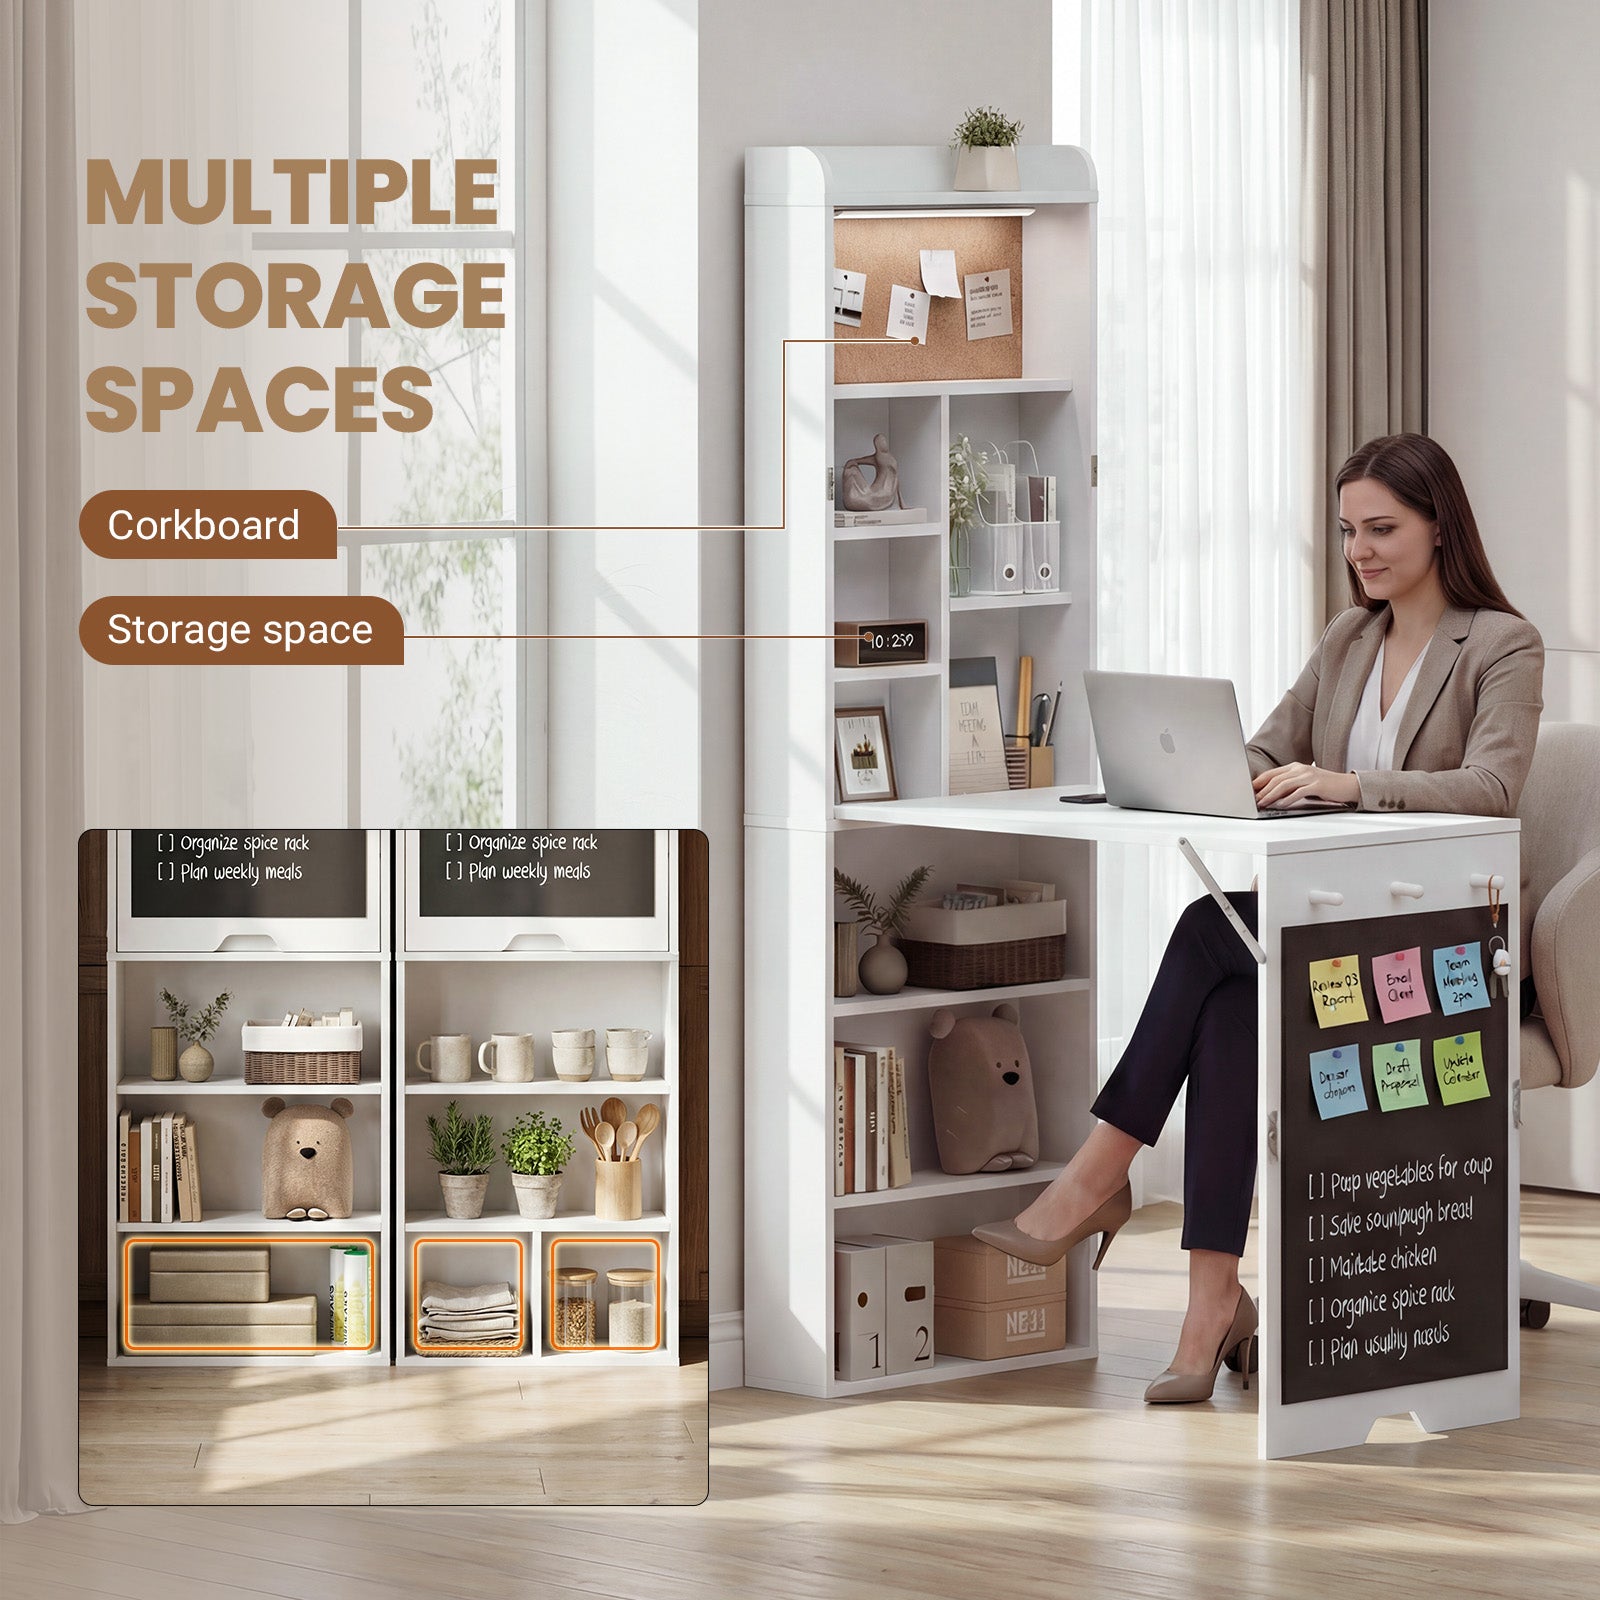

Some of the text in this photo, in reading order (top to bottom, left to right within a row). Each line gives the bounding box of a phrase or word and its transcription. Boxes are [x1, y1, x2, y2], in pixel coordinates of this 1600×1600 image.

[180, 834, 239, 859] Organize
[243, 834, 279, 859] spice
[284, 834, 310, 851] rack
[468, 833, 528, 858] Organize
[532, 833, 568, 858] spice
[572, 833, 598, 850] rack
[180, 862, 208, 883] Plan
[214, 862, 260, 887] weekly
[265, 862, 303, 881] meals
[468, 861, 496, 882] Plan
[502, 861, 548, 886] weekly
[554, 861, 592, 880] meals
[1365, 1160, 1434, 1200] vegetables
[1438, 1153, 1458, 1180] for
[1329, 1212, 1362, 1237] Save
[1391, 1243, 1437, 1270] chicken
[1431, 1278, 1456, 1304] rack
[868, 1332, 882, 1370] 1
[914, 1325, 931, 1362] 2
